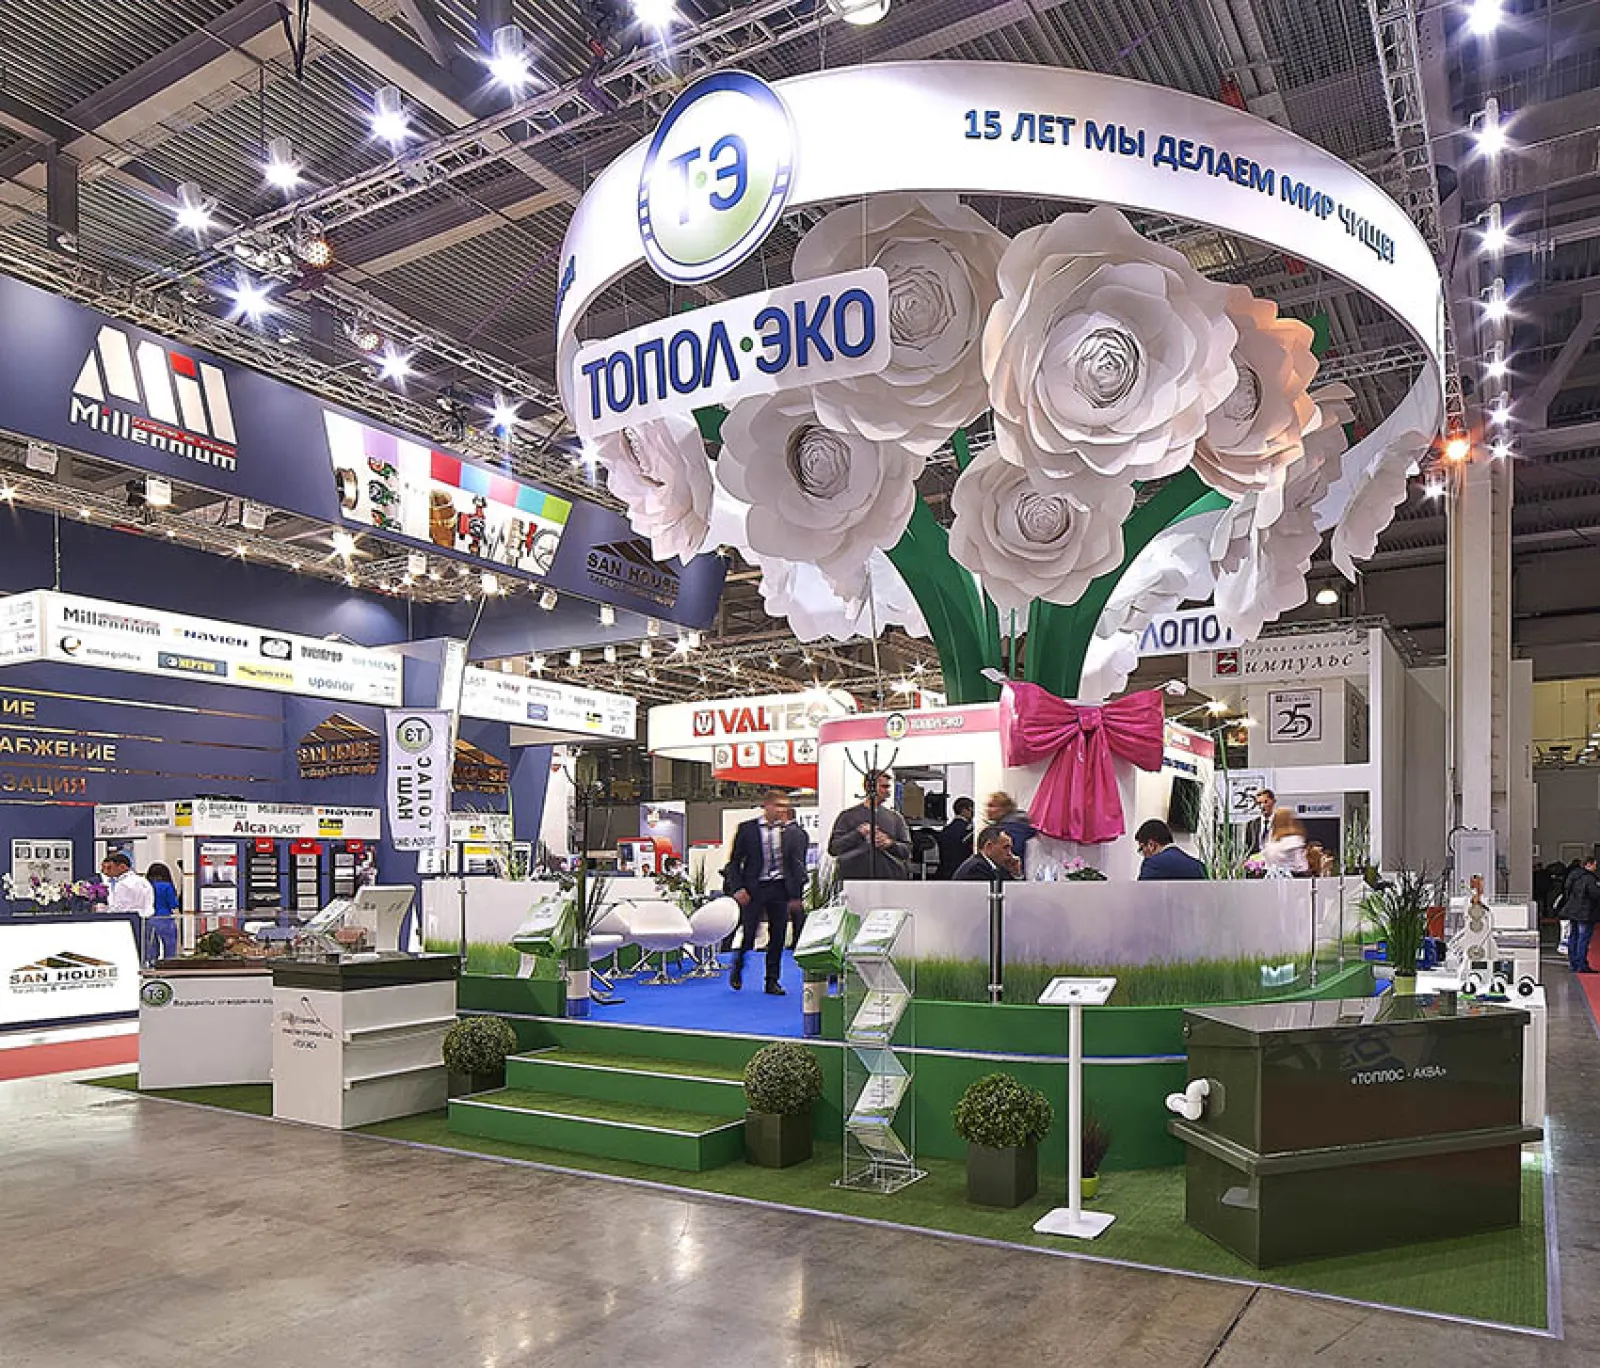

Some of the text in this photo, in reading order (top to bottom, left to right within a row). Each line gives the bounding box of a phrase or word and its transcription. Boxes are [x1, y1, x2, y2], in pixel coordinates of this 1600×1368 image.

[965, 109, 1397, 264] 15 ЛЕТ МЫ ДЕЛАЕМ МИР ЧИЩЕ!
[70, 397, 237, 472] Millennium
[587, 553, 622, 577] SAN
[628, 567, 679, 595] HOUSE
[63, 606, 160, 637] Millennium
[308, 676, 355, 694] uponor
[1277, 703, 1313, 738] 25
[233, 820, 267, 834] Alca
[9, 967, 119, 985] SAN HOUSE
